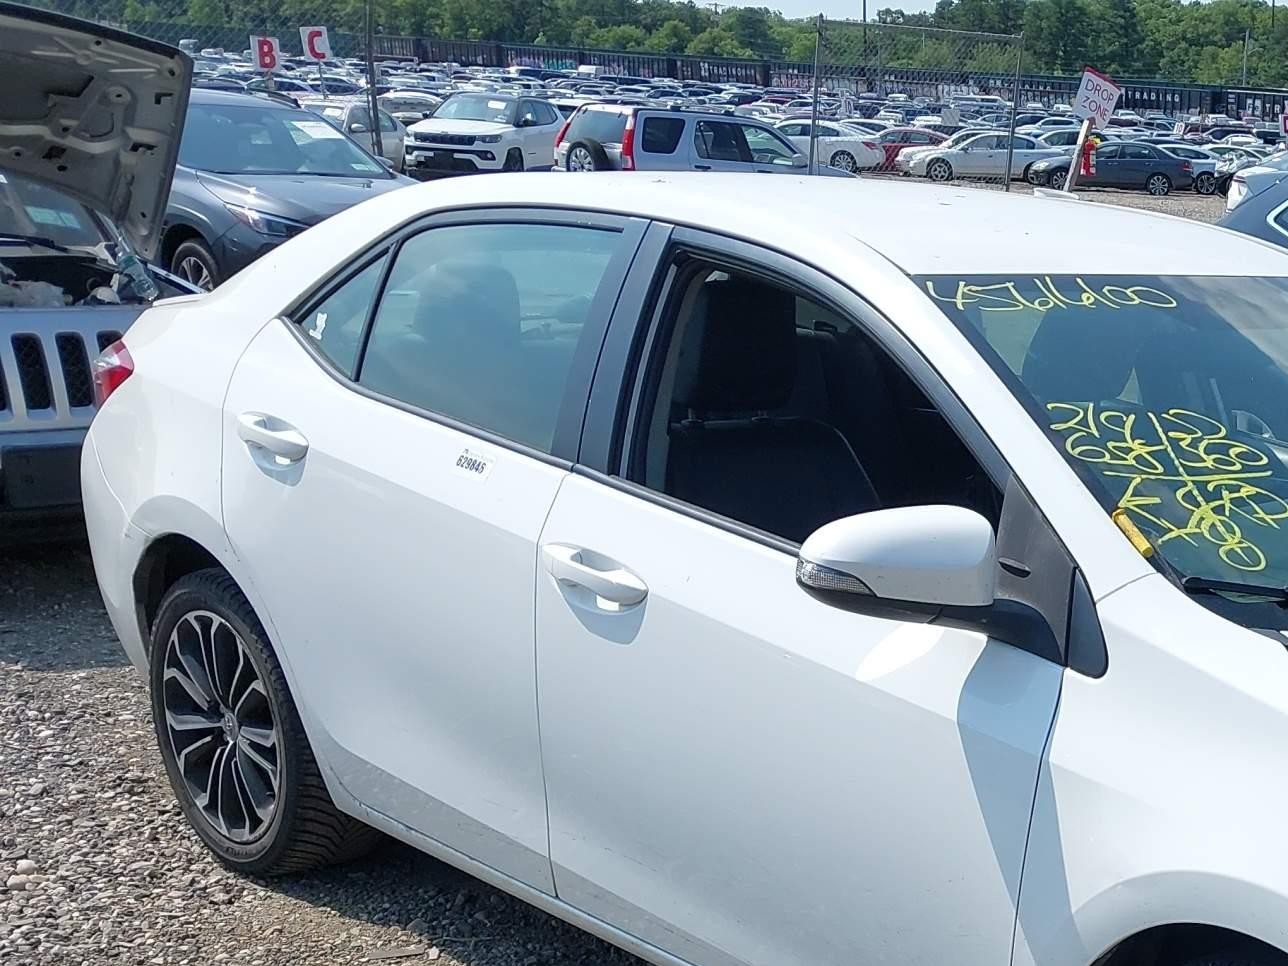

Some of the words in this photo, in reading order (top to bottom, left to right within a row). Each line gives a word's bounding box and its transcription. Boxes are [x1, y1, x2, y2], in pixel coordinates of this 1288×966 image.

[257, 39, 276, 68] B
[307, 31, 326, 59] C
[1085, 79, 1114, 104] DROP
[1127, 91, 1180, 103] TRADING
[1081, 96, 1109, 121] ZONE
[926, 276, 1177, 312] 45616100
